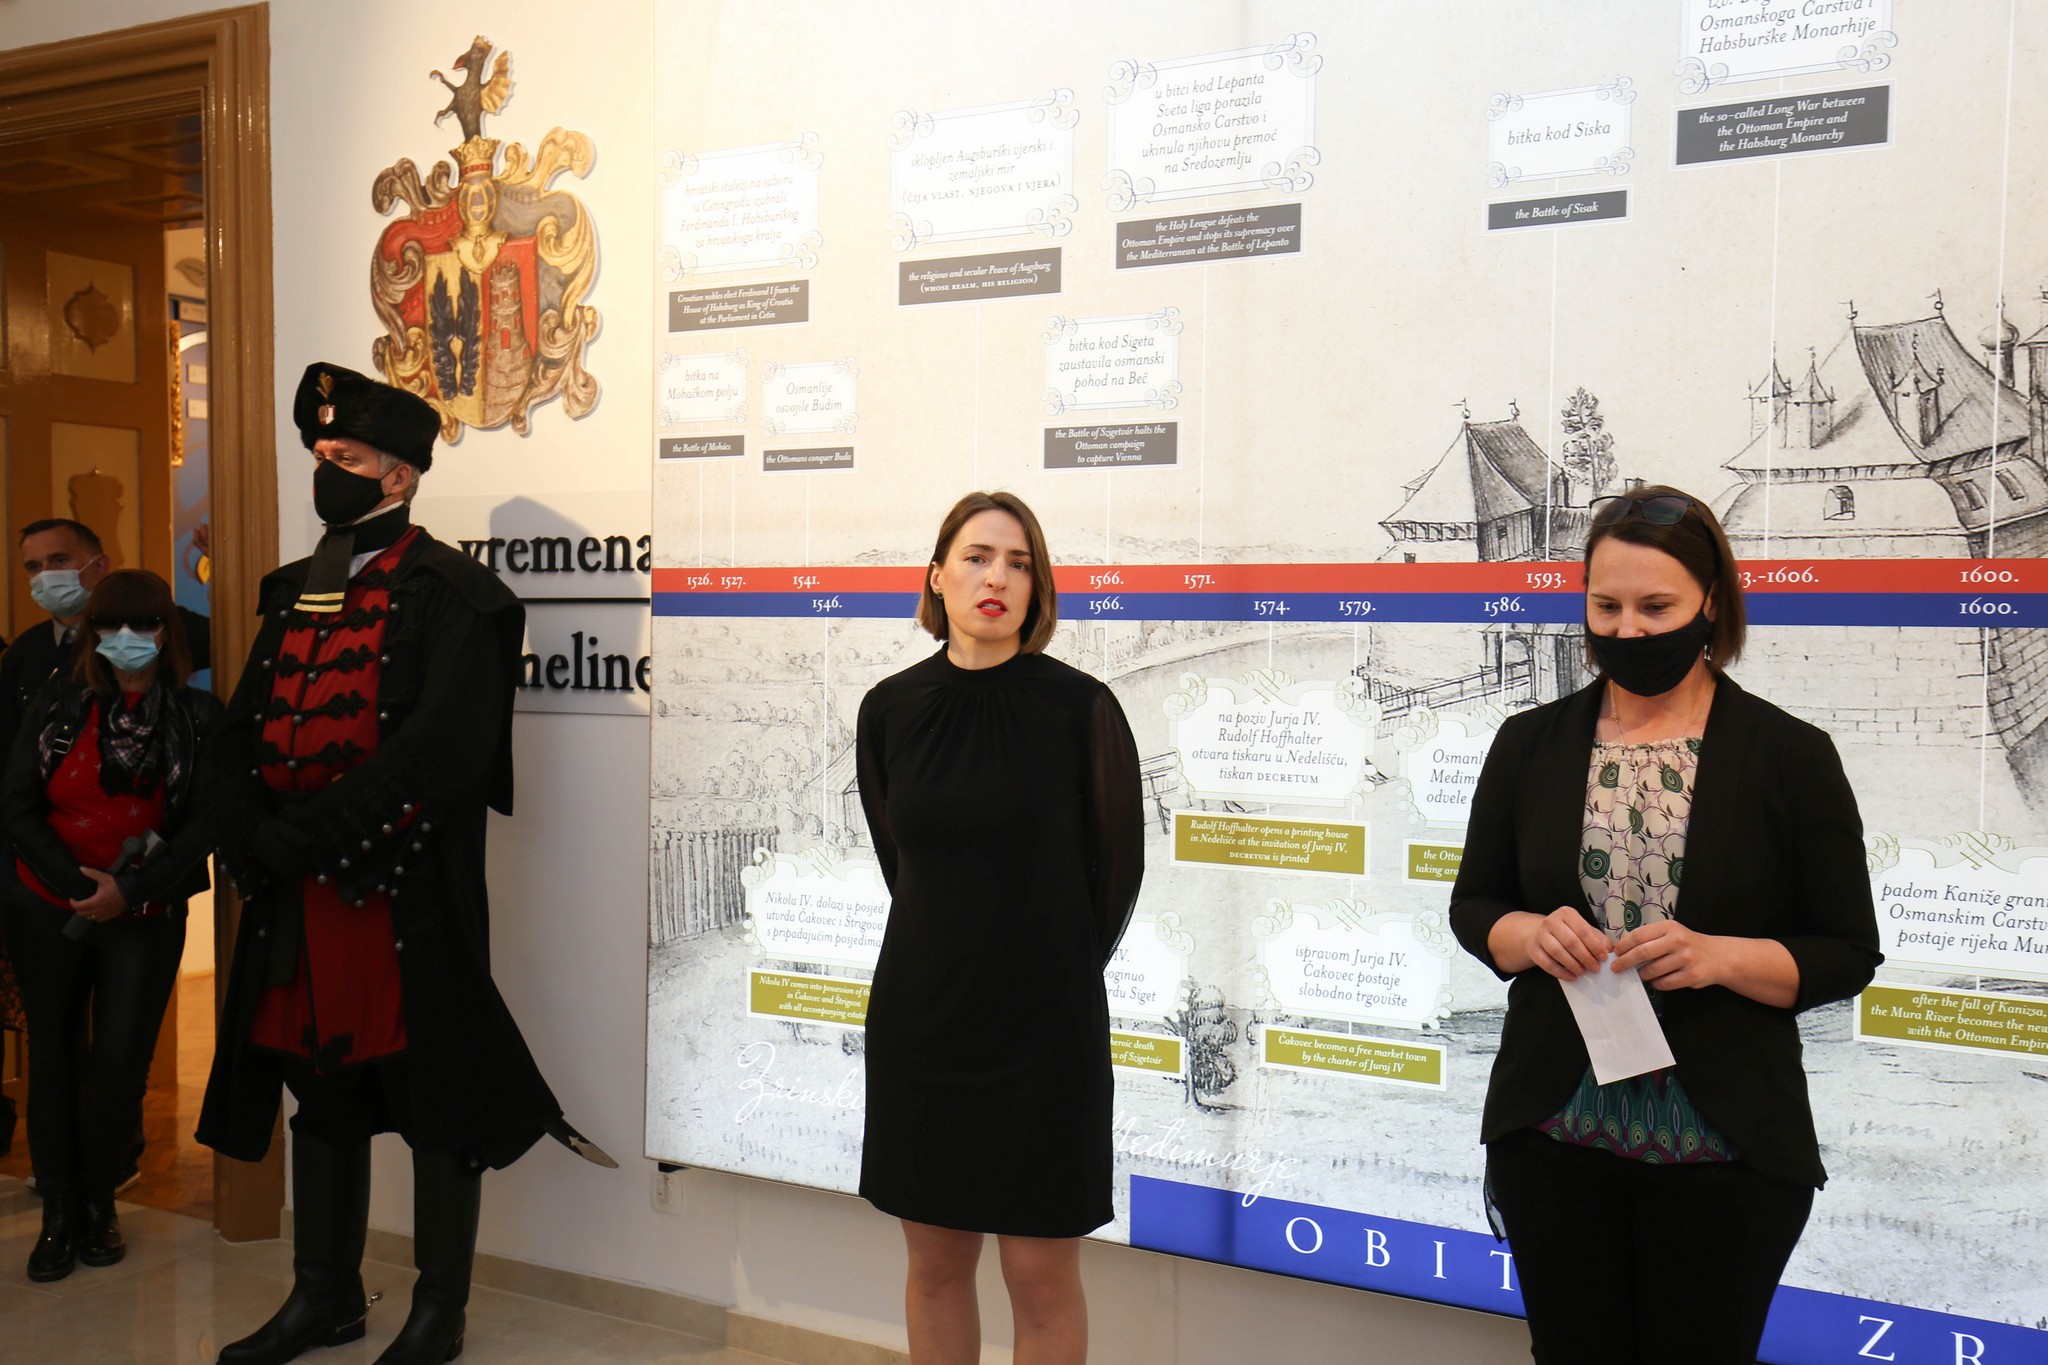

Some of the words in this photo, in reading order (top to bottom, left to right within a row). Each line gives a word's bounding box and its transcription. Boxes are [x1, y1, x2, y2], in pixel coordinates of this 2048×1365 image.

[1700, 7, 1796, 31] Osmanskoga
[1802, 0, 1862, 17] Carstva
[1699, 28, 1786, 53] Habsburške
[1792, 17, 1876, 41] Monarhije
[1155, 88, 1162, 99] u
[1166, 82, 1190, 98] bitci
[1193, 77, 1214, 93] kod
[1217, 73, 1265, 93] Lepanta
[1157, 102, 1188, 118] Sveta
[1190, 99, 1211, 117] liga
[1214, 91, 1262, 115] porazila
[1699, 112, 1715, 124] the
[1716, 105, 1765, 121] so-called
[1767, 102, 1794, 117] Long
[1797, 100, 1819, 111] War
[1822, 96, 1865, 109] between
[1152, 119, 1210, 137] Osmansko
[1214, 113, 1259, 129] Carstvo
[1262, 111, 1267, 123] i
[1508, 129, 1541, 145] bitka
[1545, 123, 1571, 140] kod
[1575, 120, 1611, 137] Siska
[1717, 126, 1733, 137] the
[1736, 121, 1783, 134] Ottoman
[1786, 116, 1824, 131] Empire
[1826, 111, 1848, 124] and
[1142, 140, 1184, 157] ukinula
[1187, 137, 1231, 156] njihovu
[1233, 128, 1278, 150] premoć
[1719, 141, 1735, 152] the
[1737, 136, 1788, 150] Habsburg
[1789, 129, 1845, 144] Monarchy
[1164, 163, 1178, 174] na
[1181, 151, 1252, 172] Sredozemlju
[1515, 209, 1530, 219] the
[1531, 206, 1560, 218] Battle
[1561, 204, 1574, 218] of
[1573, 201, 1599, 214] Sisak
[1069, 338, 1095, 352] bitka
[1098, 335, 1119, 350] kod
[1121, 334, 1155, 352] Sigeta
[1058, 354, 1112, 372] zaustavila
[1114, 351, 1165, 367] osmanski
[1073, 373, 1108, 393] pohod
[1111, 377, 1125, 387] na
[1128, 371, 1149, 385] Beč
[687, 573, 713, 590] 1526.
[721, 576, 746, 590] 1527.
[793, 575, 820, 590] 1541.
[1089, 571, 1124, 589] 1566.
[1184, 574, 1215, 589] 1571.
[1526, 572, 1567, 589] 1593.
[1960, 565, 2019, 583] 1600.
[812, 595, 843, 612] 1546.
[1089, 596, 1124, 614] 1566.
[1253, 600, 1290, 616] 1574.
[1338, 600, 1376, 616] 1579.
[1483, 596, 1525, 616] 1586.
[1959, 597, 2018, 615] 1600.
[1218, 713, 1232, 724] na
[1235, 712, 1266, 727] poziv
[1267, 711, 1299, 729] Jurja
[1302, 712, 1321, 726] IV.
[1218, 728, 1259, 747] Rudolf
[1260, 730, 1323, 749] Hoffhalter
[1192, 749, 1229, 761] otvara
[1232, 750, 1272, 763] tiskaru
[1275, 754, 1283, 763] u
[1285, 750, 1348, 767] Nedelišću,
[1219, 767, 1253, 781] tiskan
[1257, 773, 1319, 784] DECRETUM
[1190, 819, 1217, 833] Rudolf
[1218, 821, 1259, 835] Hoffhalter
[1260, 825, 1283, 836] opens
[1291, 825, 1324, 840] printing
[1325, 828, 1349, 839] house
[1190, 833, 1198, 842] in
[1199, 833, 1236, 845] Nedelišće
[1237, 836, 1246, 845] at
[1247, 837, 1260, 846] the
[1261, 838, 1300, 849] invitation
[1301, 839, 1312, 853] of
[1311, 841, 1333, 855] Juraj
[1229, 851, 1270, 861] DECRETUM
[1272, 853, 1279, 861] is
[1280, 854, 1310, 865] printed
[765, 891, 797, 906] Nikola
[800, 894, 813, 907] IV.
[816, 896, 844, 911] dolazi
[846, 902, 852, 910] u
[854, 901, 885, 917] posjed
[1881, 882, 1938, 901] padom
[1944, 884, 2001, 906] Kaniže
[766, 910, 795, 922] utvrda
[798, 908, 836, 926] Čakovec
[838, 917, 842, 926] i
[844, 912, 883, 933] Štrigova
[1889, 903, 1985, 926] Osmanskim
[767, 928, 771, 936] s
[772, 928, 833, 944] pripadajućim
[1897, 929, 1955, 952] postaje
[1961, 933, 2008, 954] rijeka
[1295, 945, 1350, 962] ispravom
[1351, 949, 1384, 969] Jurja
[1388, 952, 1407, 967] IV.
[1303, 960, 1354, 981] Čakovec
[1357, 971, 1401, 990] postaje
[1299, 983, 1352, 1001] slobodno
[1356, 991, 1408, 1008] trgovište
[1912, 993, 1939, 1008] after
[1941, 996, 1958, 1008] the
[1960, 998, 1980, 1013] fall
[1983, 1000, 1998, 1015] of
[1997, 1001, 2047, 1018] Kanizsa,
[1871, 1004, 1887, 1016] the
[1890, 1007, 1922, 1020] Mura
[1925, 1010, 1955, 1023] River
[1957, 1013, 2004, 1029] becomes
[2006, 1018, 2024, 1030] the
[1907, 1026, 1931, 1037] with
[1934, 1027, 1951, 1039] the
[1955, 1029, 2007, 1045] Ottoman
[1278, 1033, 1312, 1048] Čakovec
[1314, 1039, 1347, 1052] becomes
[1349, 1045, 1354, 1053] a
[1355, 1045, 1372, 1057] free
[1374, 1048, 1403, 1059] market
[1405, 1053, 1427, 1062] town
[1302, 1051, 1311, 1063] by
[1313, 1053, 1326, 1063] the
[1327, 1055, 1356, 1067] charter
[1359, 1059, 1370, 1072] of
[1368, 1059, 1391, 1075] Juraj
[1392, 1062, 1405, 1072] IV
[735, 1041, 865, 1122] Zrinski
